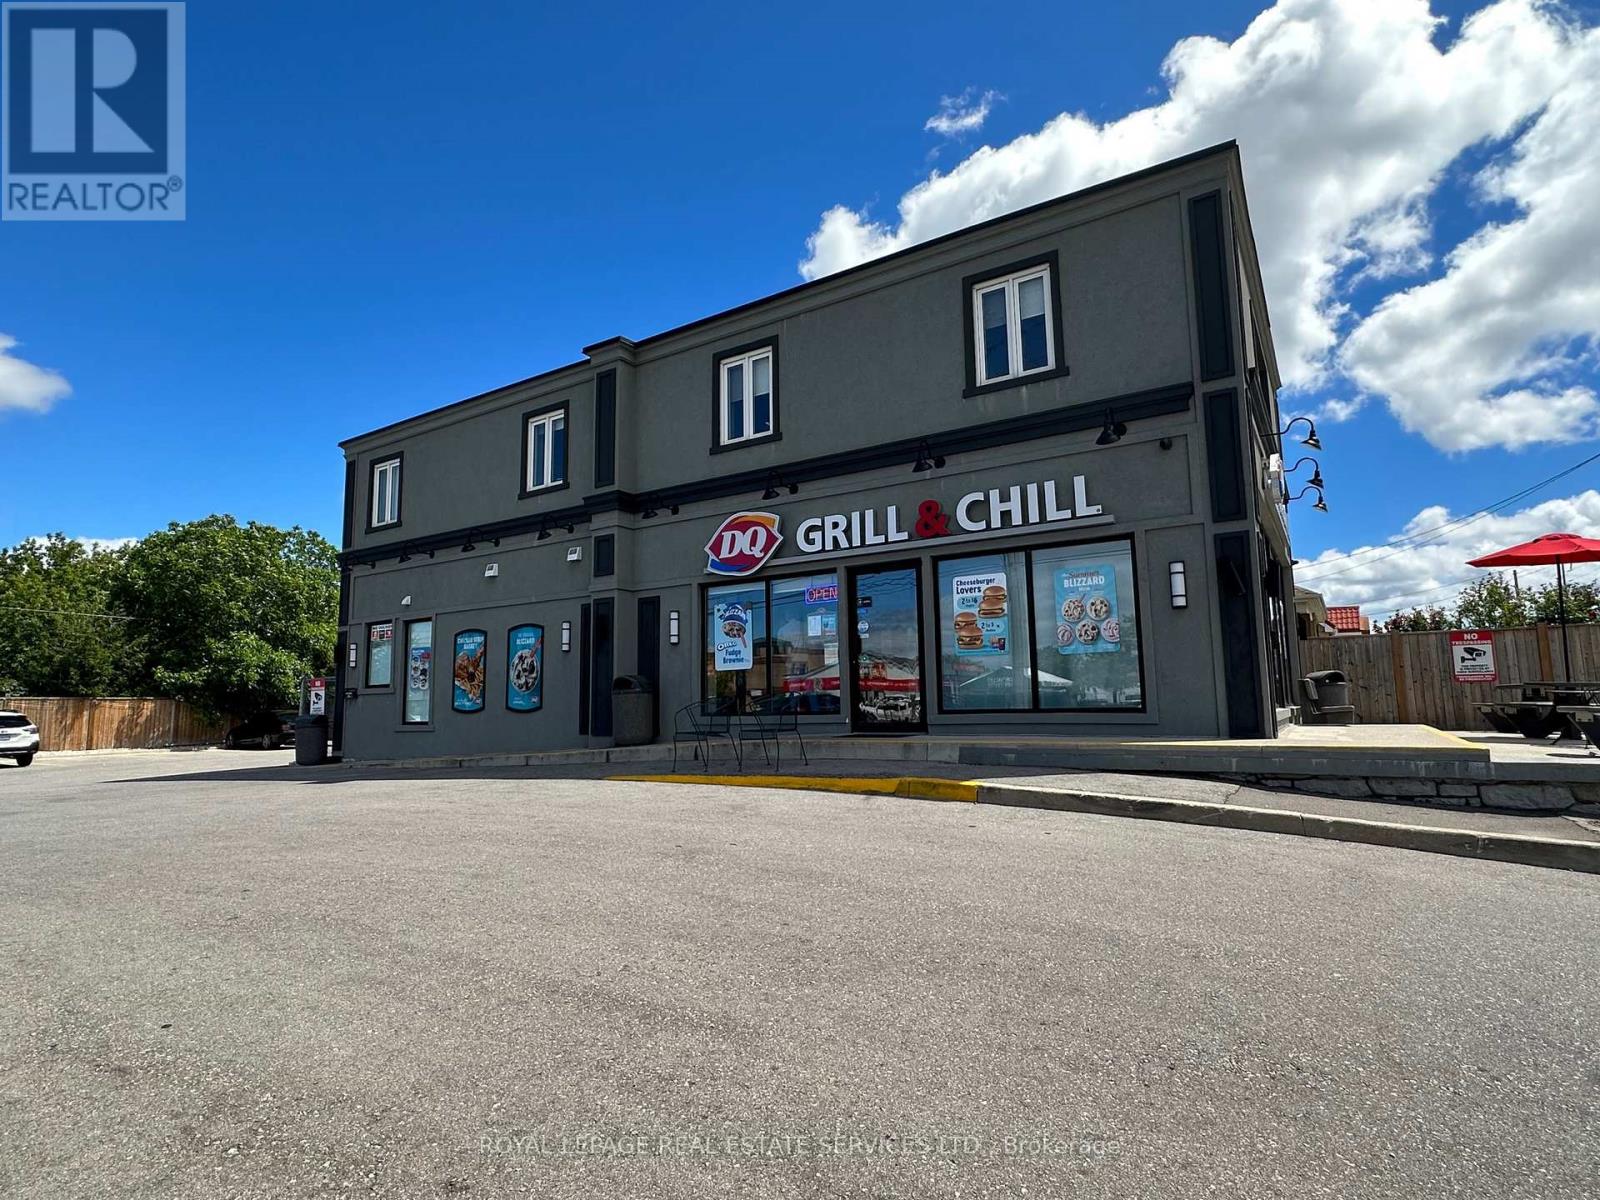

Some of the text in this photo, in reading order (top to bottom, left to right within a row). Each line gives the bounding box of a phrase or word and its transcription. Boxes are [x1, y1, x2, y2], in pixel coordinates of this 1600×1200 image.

[719, 475, 1102, 559] DQ GRILL & CHILL
[956, 578, 996, 587] Cheeseburger
[1064, 576, 1105, 588] BLIZZARD
[807, 587, 838, 602] OPEN
[956, 586, 982, 595] Lovers
